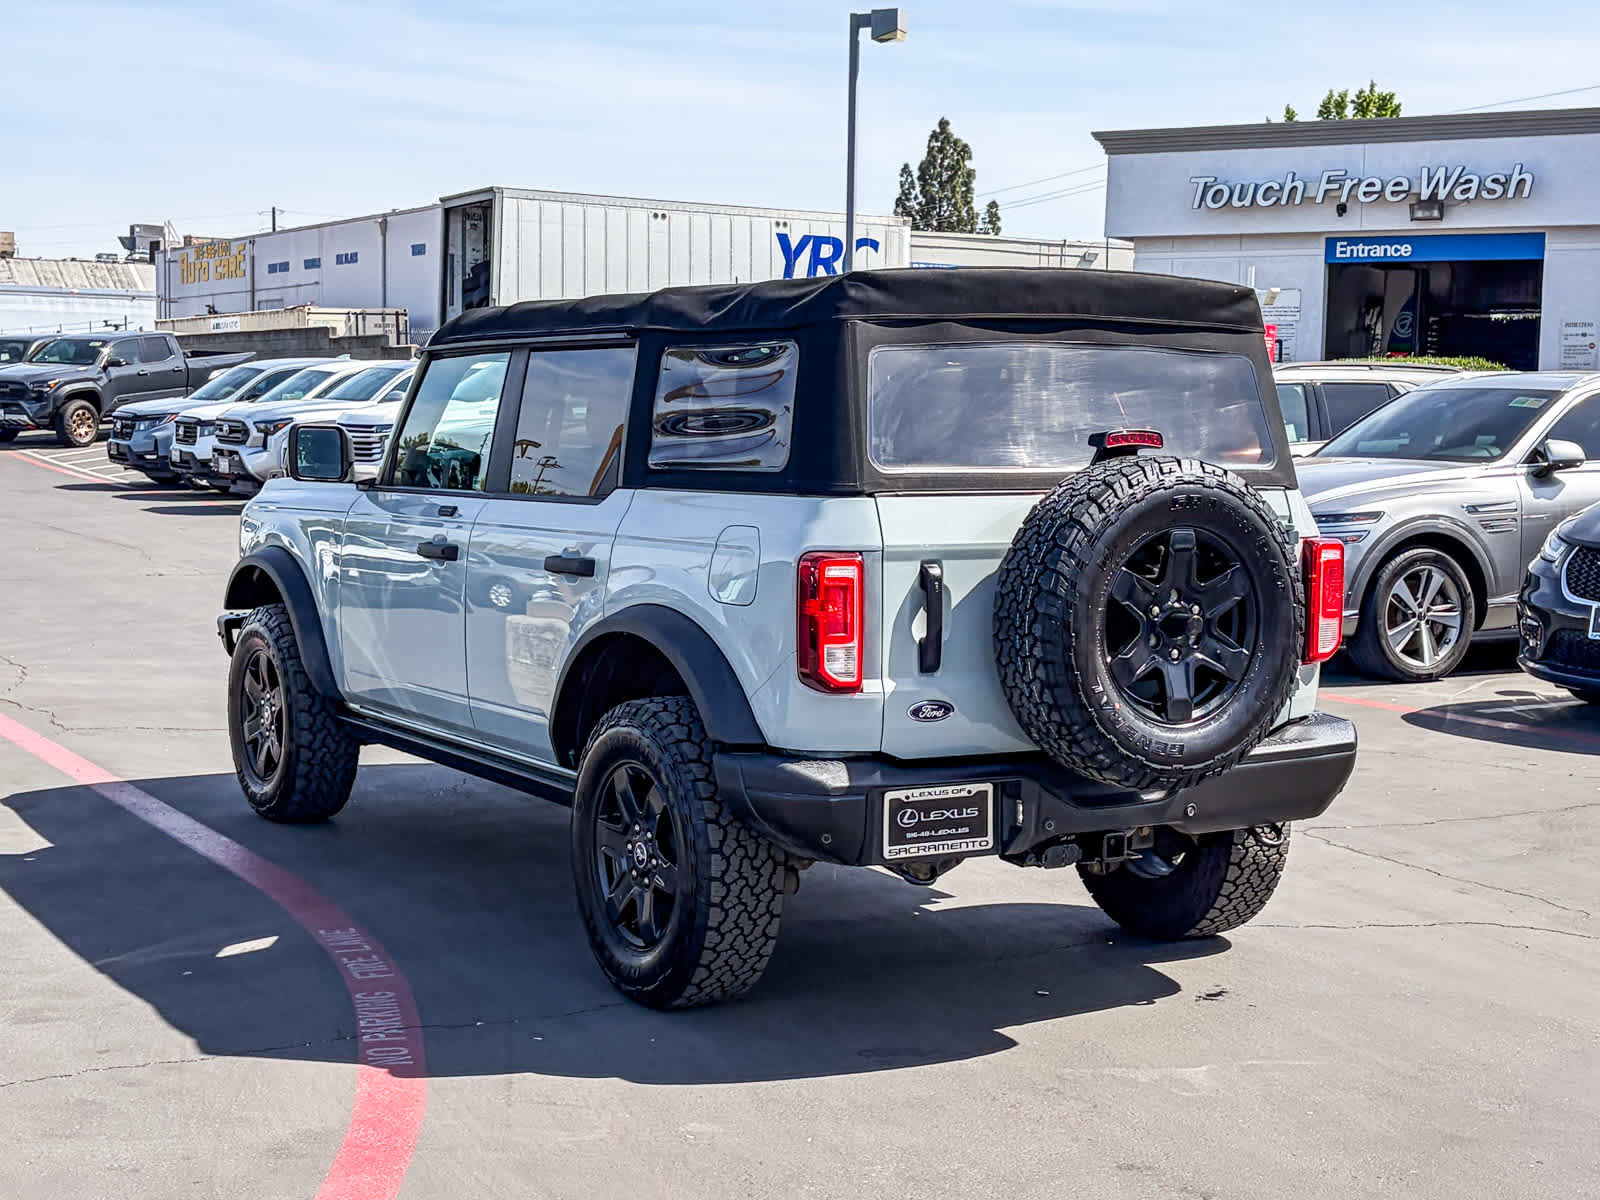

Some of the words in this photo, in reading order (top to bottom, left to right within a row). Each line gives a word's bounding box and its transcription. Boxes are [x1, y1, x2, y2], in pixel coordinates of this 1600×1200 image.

[1190, 171, 1305, 210] Touch
[1315, 168, 1411, 204] Free
[1418, 162, 1534, 202] Wash
[1335, 240, 1412, 259] Entrance
[911, 789, 949, 798] LEXUS
[920, 807, 979, 822] LEXUS
[888, 839, 990, 857] SACRAMENTO
[341, 954, 396, 980] FIRE
[354, 991, 408, 1043] PARKING
[366, 1047, 414, 1066] NO
